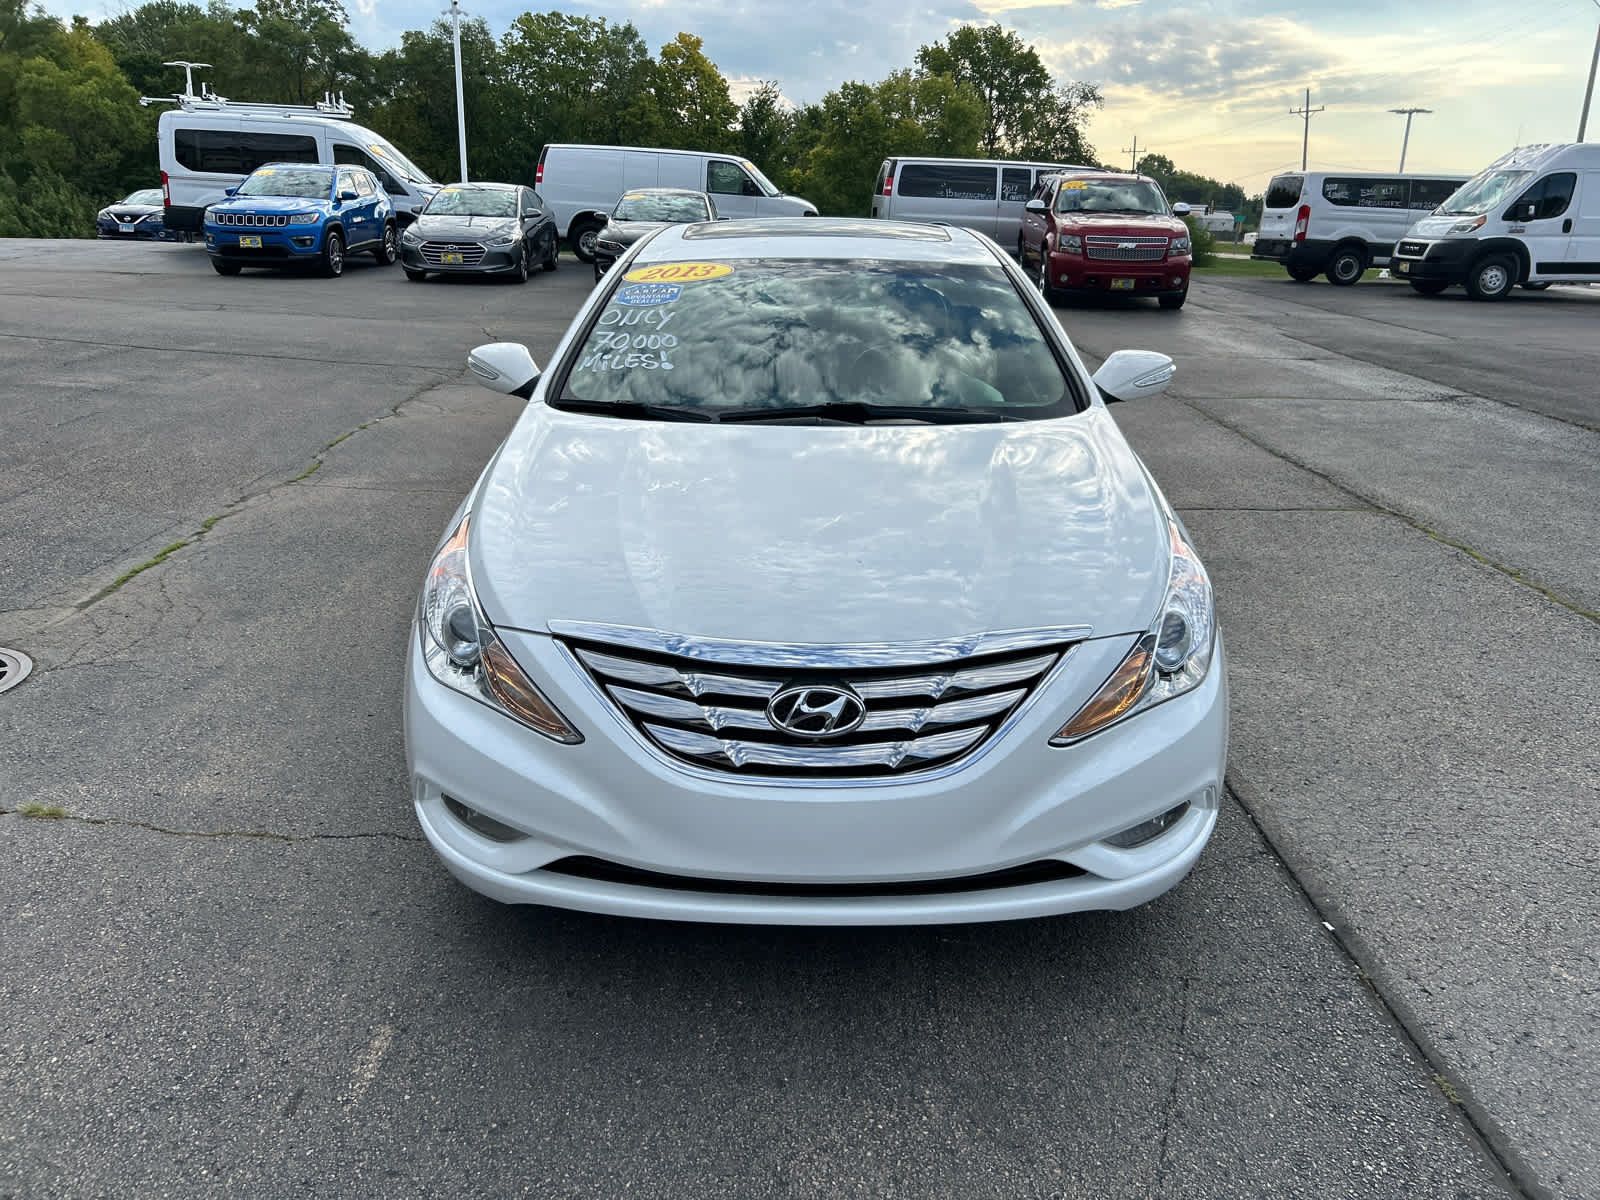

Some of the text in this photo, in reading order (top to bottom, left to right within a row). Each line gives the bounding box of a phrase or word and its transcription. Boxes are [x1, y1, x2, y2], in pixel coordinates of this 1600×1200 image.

[640, 265, 717, 280] 2013
[598, 308, 676, 331] ONLY
[593, 331, 679, 353] 70,000
